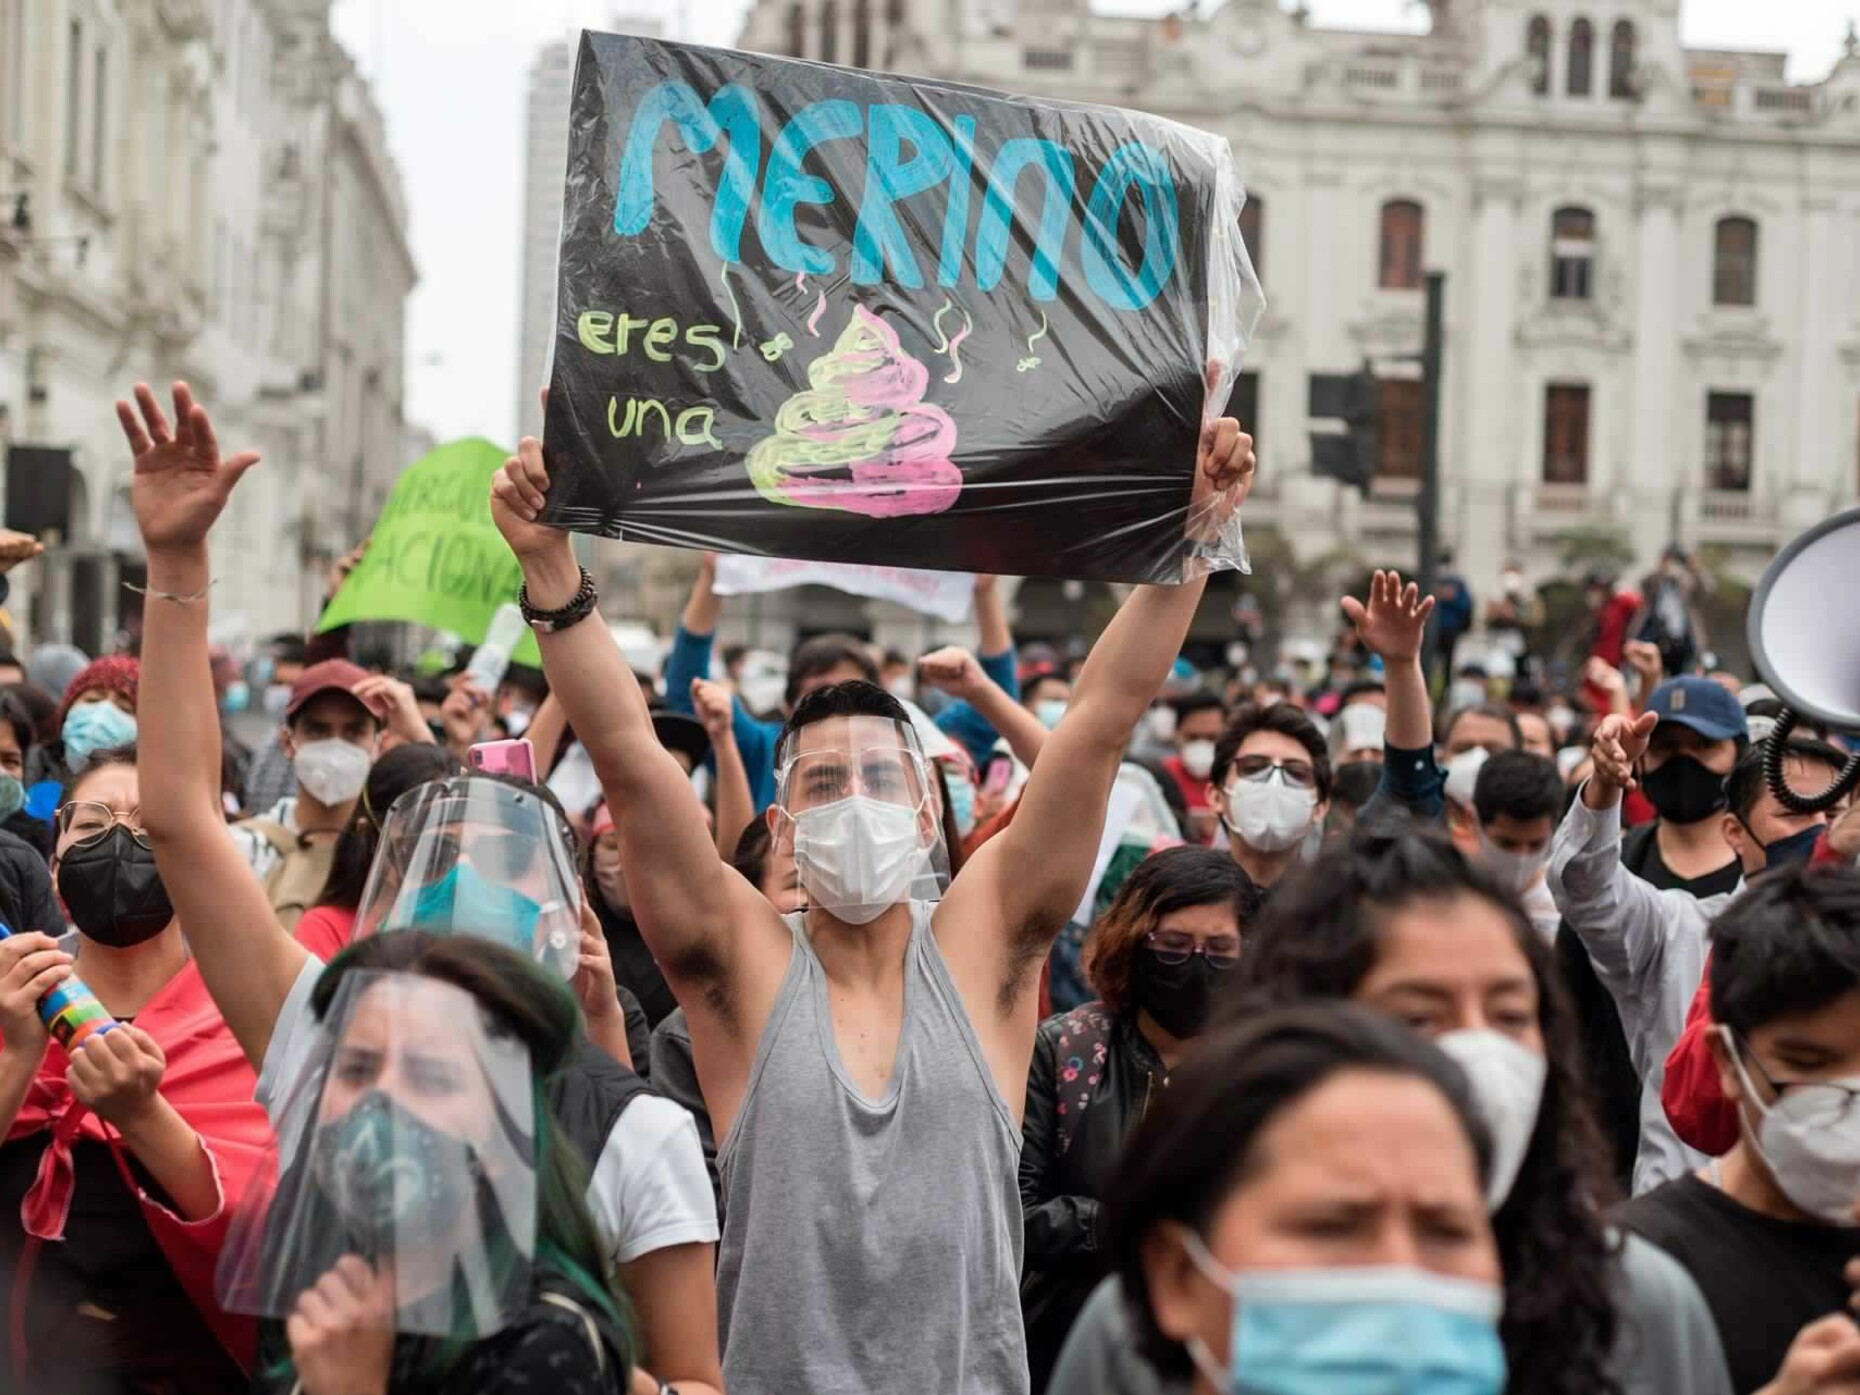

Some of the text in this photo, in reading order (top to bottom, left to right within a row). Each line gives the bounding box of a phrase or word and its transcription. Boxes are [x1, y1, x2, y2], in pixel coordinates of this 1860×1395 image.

[614, 79, 1180, 311] MERINO
[577, 310, 726, 372] eres
[607, 395, 723, 450] una
